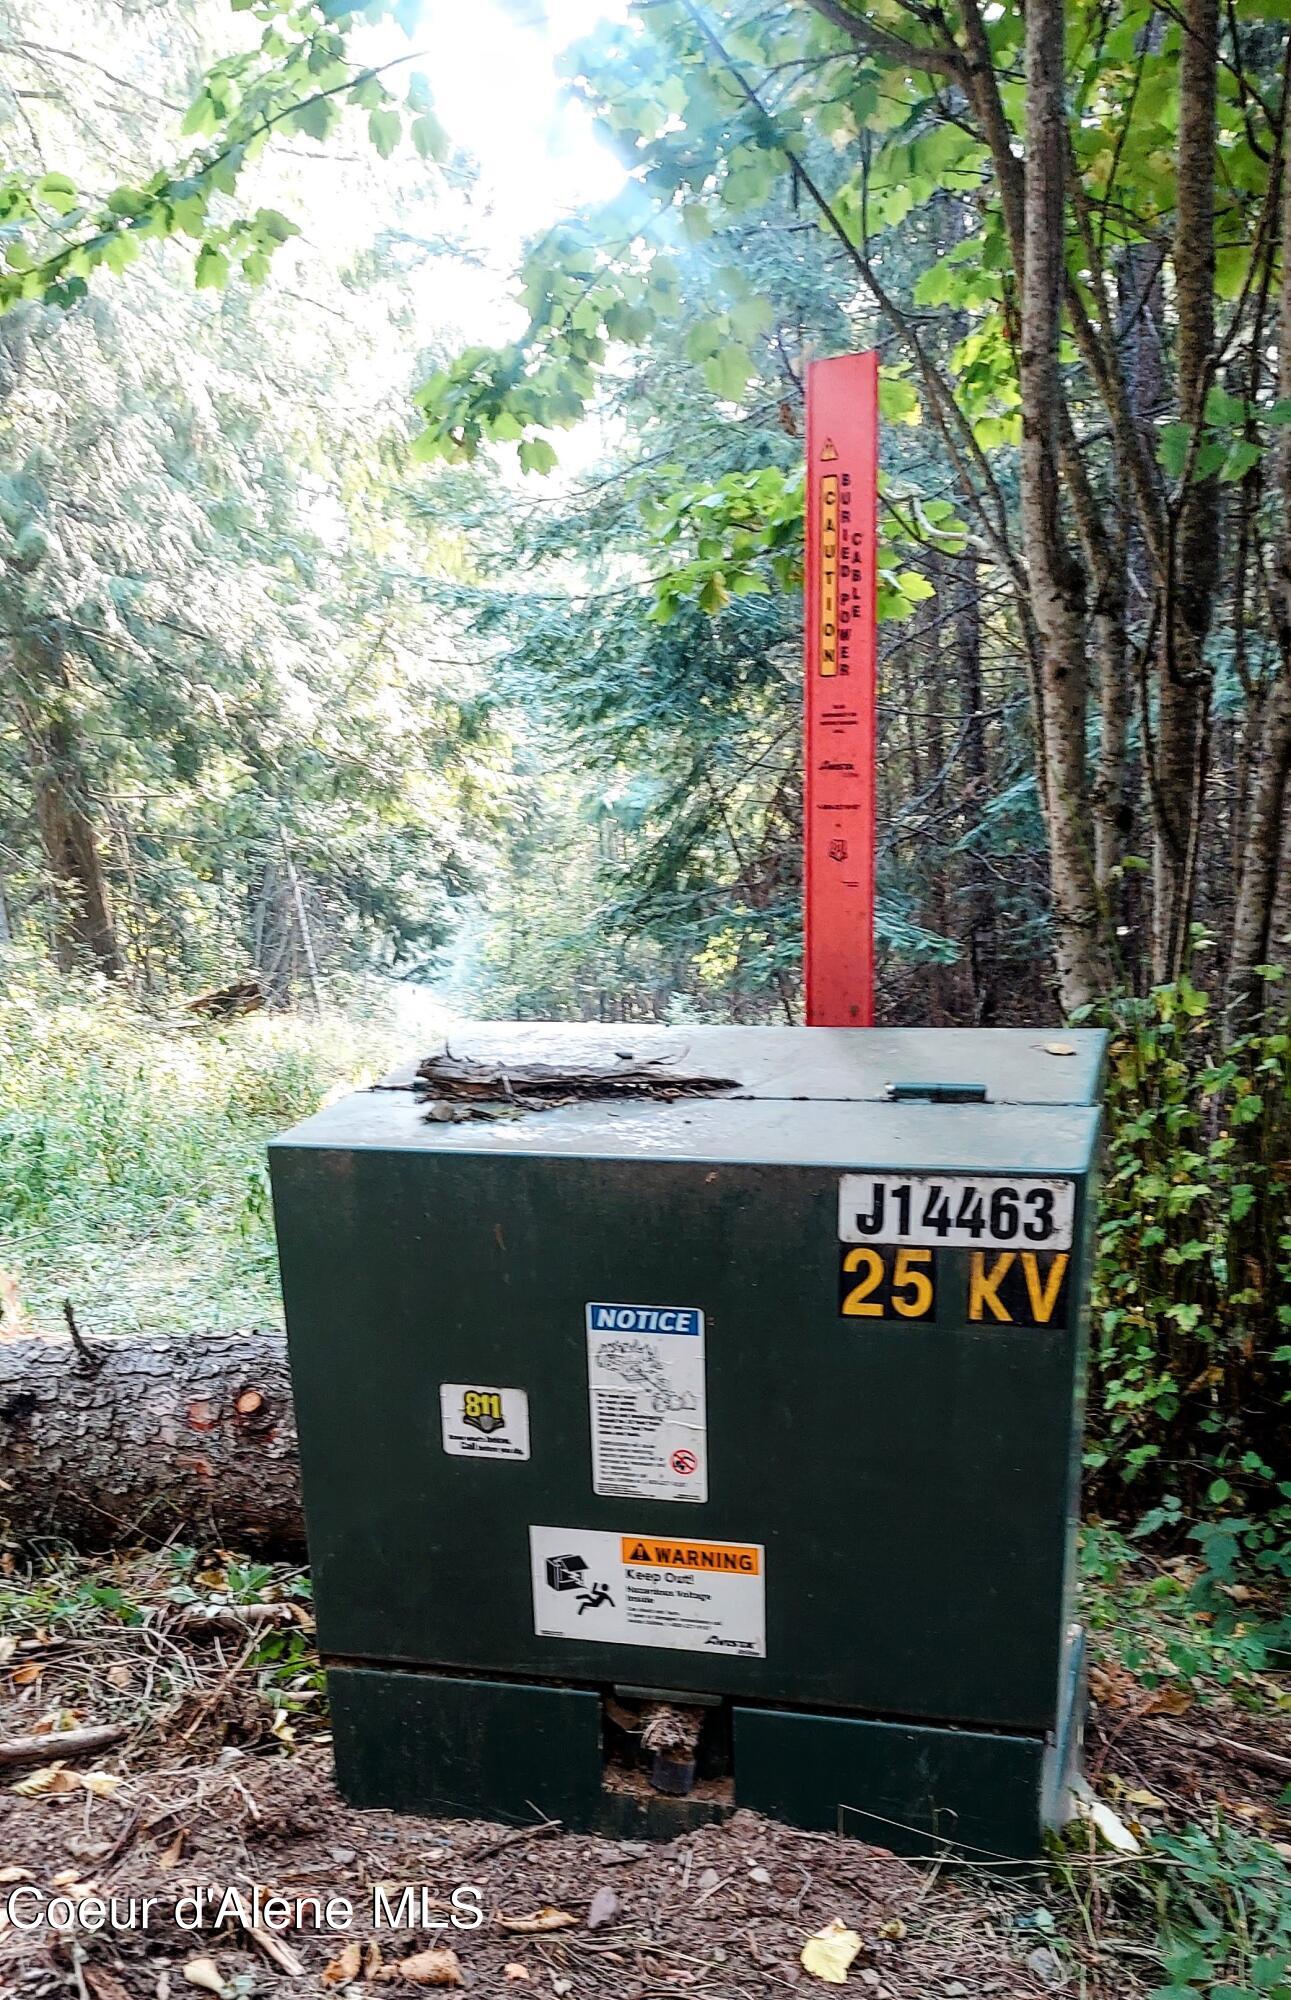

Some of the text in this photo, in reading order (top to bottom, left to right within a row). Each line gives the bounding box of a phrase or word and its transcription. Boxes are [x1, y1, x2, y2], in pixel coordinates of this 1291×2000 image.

[824, 491, 836, 662] CAUTION
[839, 473, 851, 675] BURIED POWER
[851, 532, 863, 618] CABLE
[856, 1183, 1055, 1241] J14463
[842, 1248, 1071, 1322] 25 KV
[596, 1308, 693, 1332] NOTICE
[464, 1390, 502, 1420] 811
[626, 1569, 661, 1584] Keep
[654, 1547, 753, 1571] WARNING
